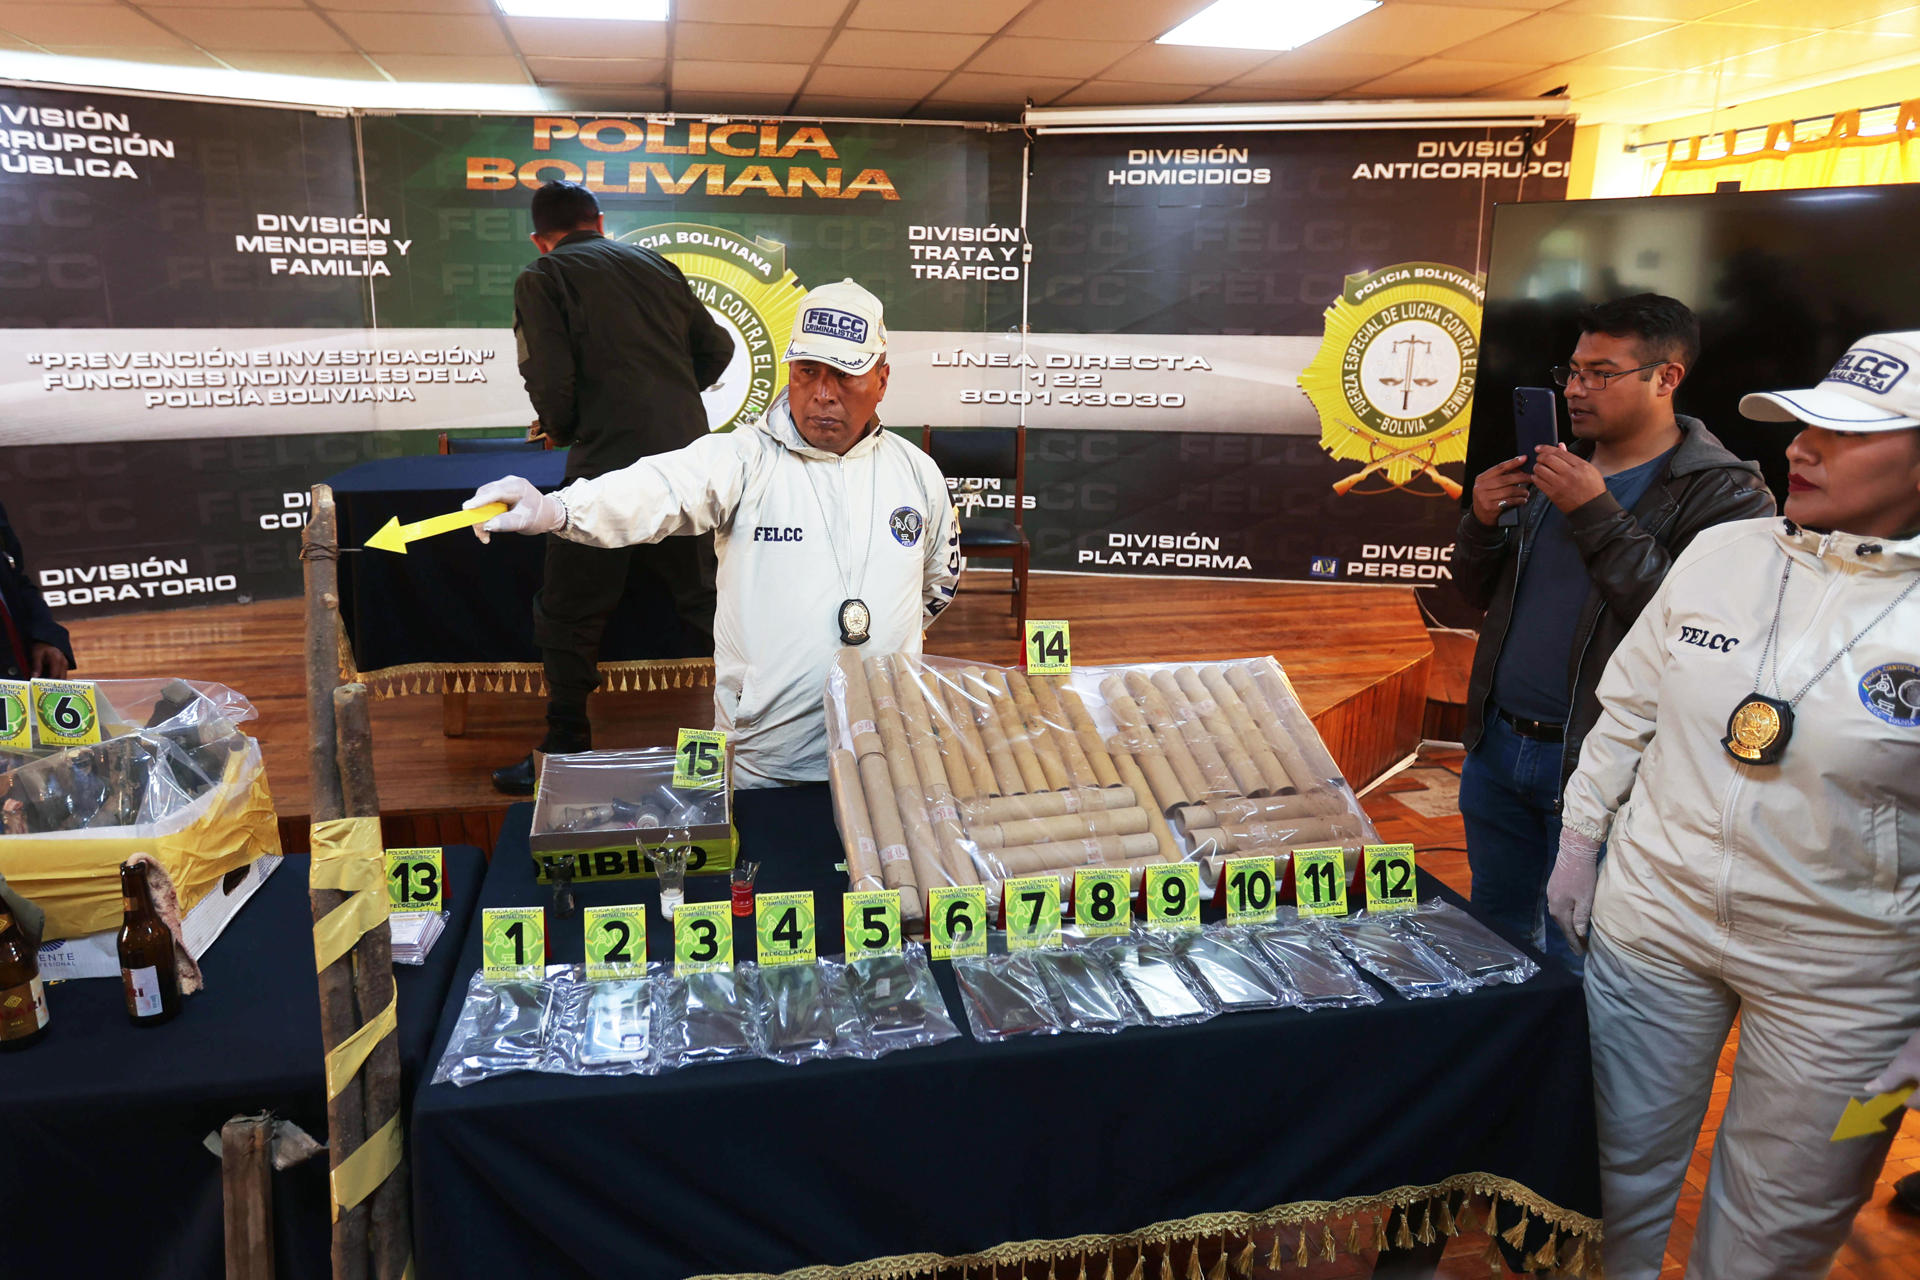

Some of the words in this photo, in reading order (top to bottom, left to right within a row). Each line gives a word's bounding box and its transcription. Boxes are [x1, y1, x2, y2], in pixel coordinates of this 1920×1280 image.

[0, 105, 130, 132] VISIÓN
[532, 117, 838, 160] POLICÍA
[1417, 135, 1548, 159] DIVISIÓN
[1128, 144, 1249, 165] DIVISIÓN
[465, 157, 901, 201] BOLIVIANA
[1107, 167, 1272, 187] HOMICIDIOS
[257, 214, 391, 235] DIVISIÓN
[909, 223, 1020, 242] DIVISIÓN
[235, 235, 388, 256] MENORES
[392, 239, 412, 256] Y
[676, 231, 773, 277] BOLIVIANA
[909, 245, 995, 261] TRATA
[1000, 246, 1017, 261] Y
[270, 257, 391, 277] FAMILIA
[911, 261, 1019, 281] TRÁFICO
[1354, 268, 1410, 300] POLICIA
[1414, 267, 1485, 300] BOLIVIANA
[808, 310, 864, 333] FELCC
[1383, 305, 1400, 323] DE
[1401, 303, 1441, 321] LUCHA
[719, 293, 763, 351] CONTRA
[753, 353, 772, 373] EL
[805, 323, 862, 341] CRIMINALISTICA
[1344, 317, 1383, 371] ESPECIAL
[1441, 310, 1477, 355] CONTRA
[253, 350, 272, 366] E
[931, 349, 1038, 369] LÍNEA
[1045, 353, 1212, 372] DIRECTA
[1462, 357, 1478, 373] EL
[42, 370, 226, 391] FUNCIONES
[232, 367, 410, 387] INDIVISIBLES
[415, 367, 450, 384] DE
[453, 367, 488, 384] LA
[1029, 372, 1103, 388] 122
[144, 385, 264, 408] POLICÍA
[268, 385, 416, 405] BOLIVIANA
[959, 389, 1187, 409] 800143030
[1343, 374, 1371, 417] FUERZA
[1440, 376, 1475, 419] CRIMEN
[753, 526, 803, 542] FELCC
[1108, 531, 1220, 552] DIVISIÓN
[39, 556, 189, 587] DIVISIÓN
[1078, 549, 1252, 571] PLATAFORMA
[1031, 630, 1068, 664] 14
[1678, 625, 1740, 653] FELCC
[54, 695, 82, 730] 6
[681, 741, 719, 776] 15
[392, 862, 437, 903] 13
[1230, 870, 1271, 912] 10
[1303, 861, 1336, 903] 11
[1371, 858, 1413, 899] 12
[1091, 881, 1115, 922] 8
[1162, 876, 1186, 916] 9
[862, 906, 890, 949] 5
[945, 900, 973, 942] 6
[1020, 891, 1046, 934] 7
[505, 921, 524, 965] 1
[603, 920, 631, 963] 2
[689, 918, 719, 962] 3
[772, 907, 803, 950] 4
